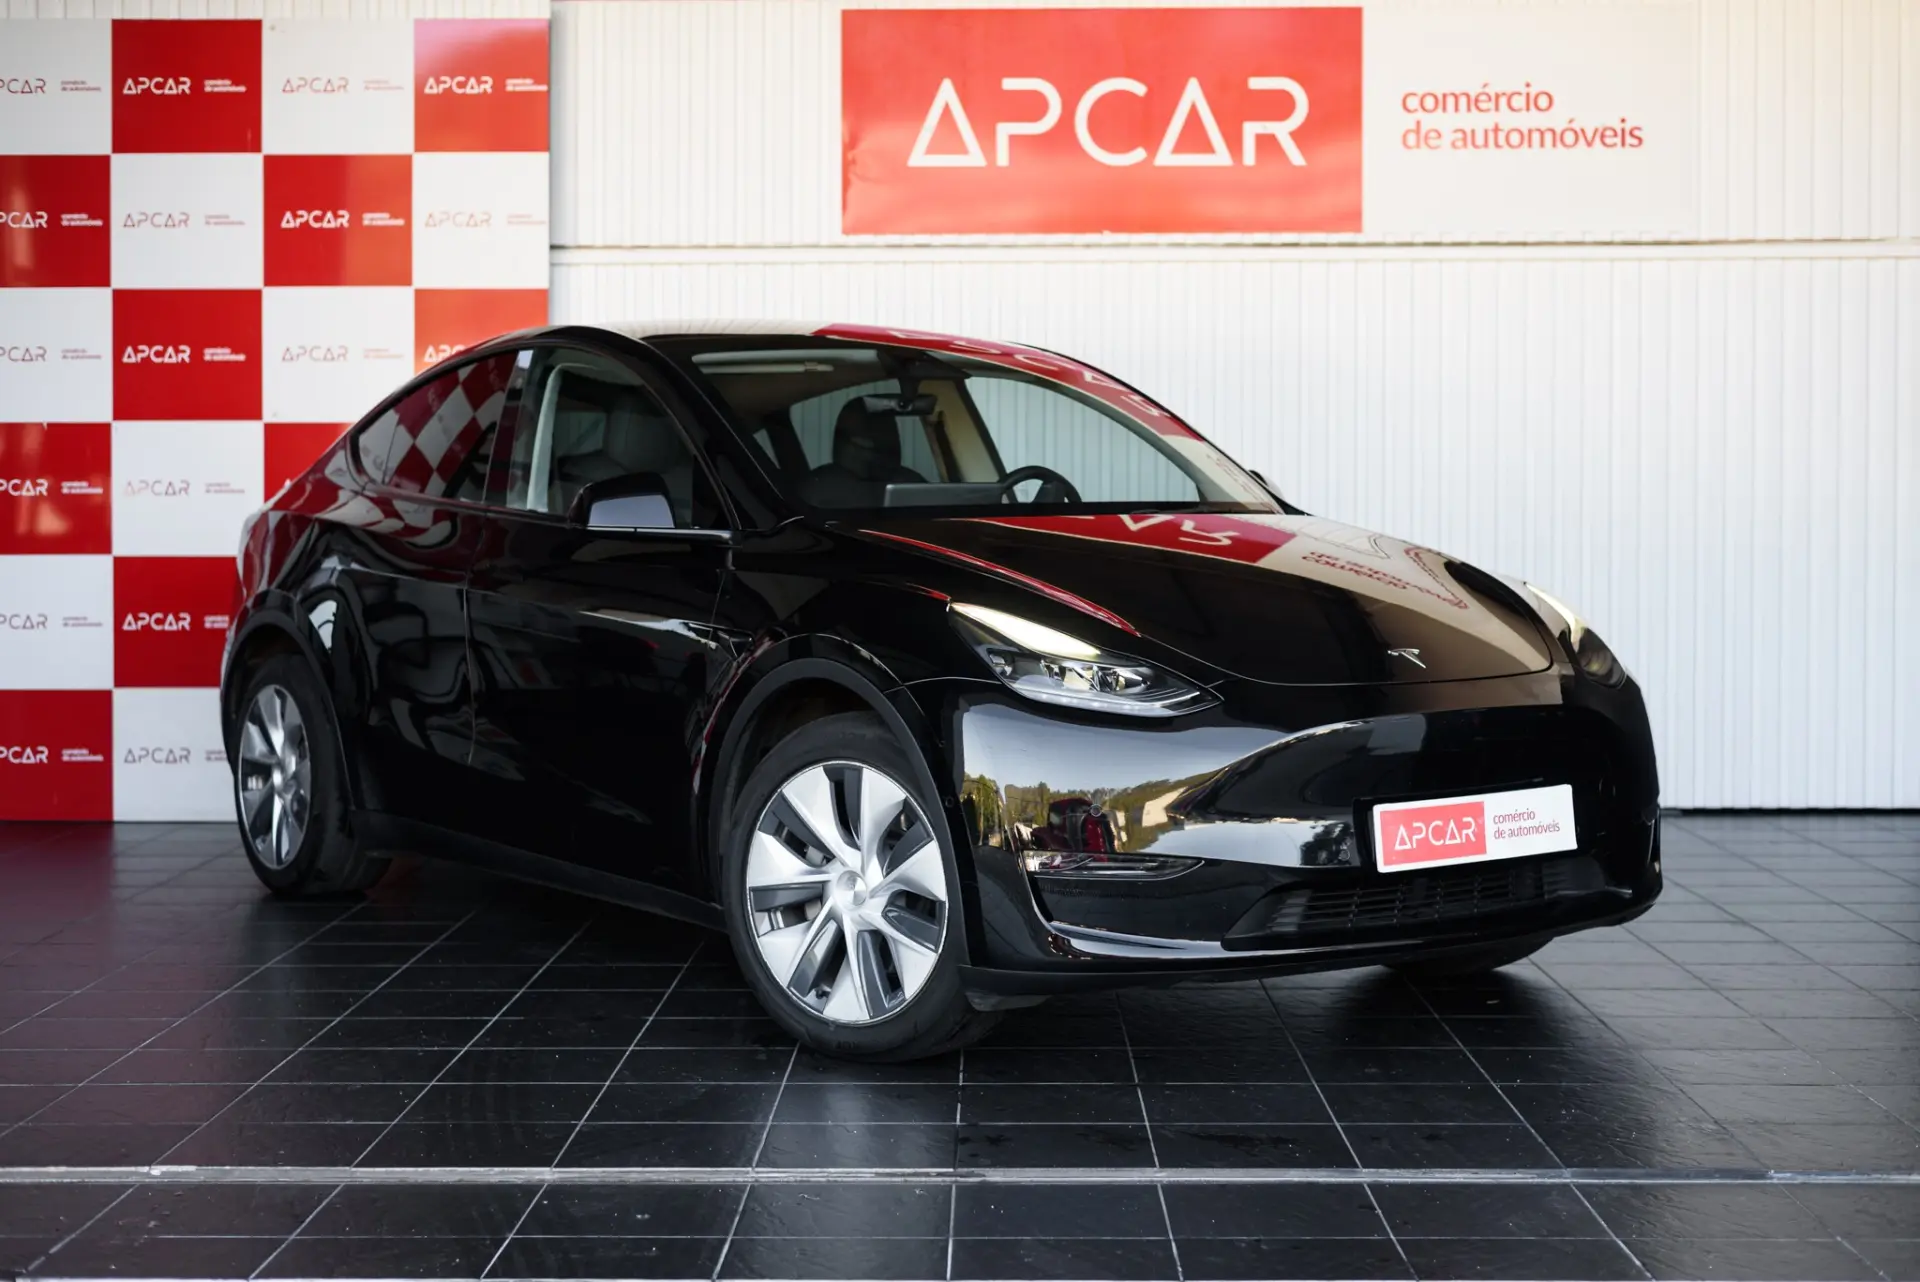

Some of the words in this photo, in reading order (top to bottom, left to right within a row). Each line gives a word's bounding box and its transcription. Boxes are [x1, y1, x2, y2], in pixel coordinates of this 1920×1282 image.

[123, 77, 191, 95] APCAR
[281, 77, 349, 94] APCAR
[424, 76, 493, 95] APCAR
[1401, 81, 1555, 114] comércio
[906, 76, 1311, 168] APCAR
[1401, 118, 1441, 150] de
[1450, 118, 1644, 150] automóveis
[123, 212, 190, 228] APCAR
[281, 210, 350, 229] APCAR
[122, 345, 191, 363] APCAR
[122, 612, 191, 631] APCAR
[123, 747, 191, 764] APCAR
[1492, 808, 1535, 825] comércio
[1394, 816, 1477, 851] APCAR
[1493, 826, 1506, 840] de
[1507, 820, 1560, 838] automóveis
